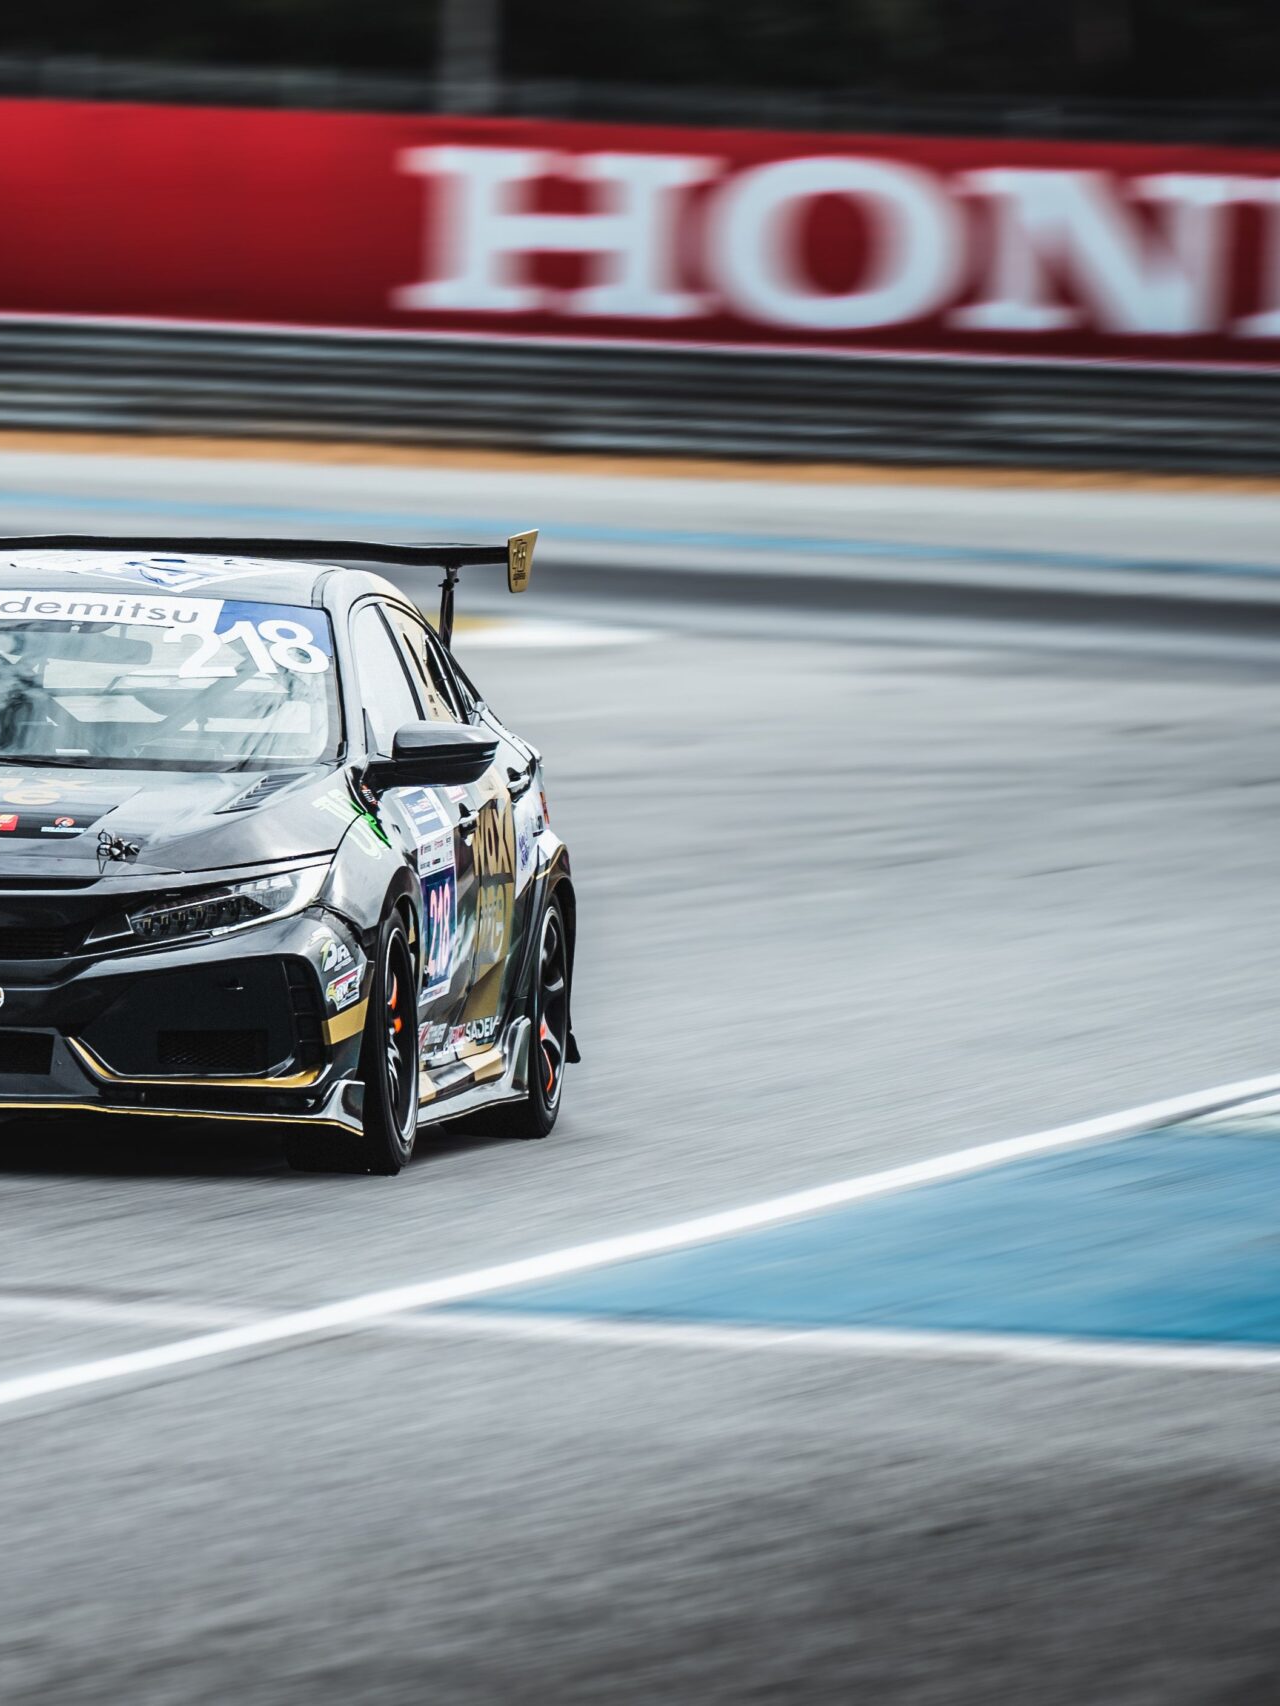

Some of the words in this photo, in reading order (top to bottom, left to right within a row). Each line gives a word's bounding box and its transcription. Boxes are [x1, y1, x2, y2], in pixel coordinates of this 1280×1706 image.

[390, 143, 1280, 338] HON
[163, 619, 330, 679] 218
[428, 882, 451, 980] 218
